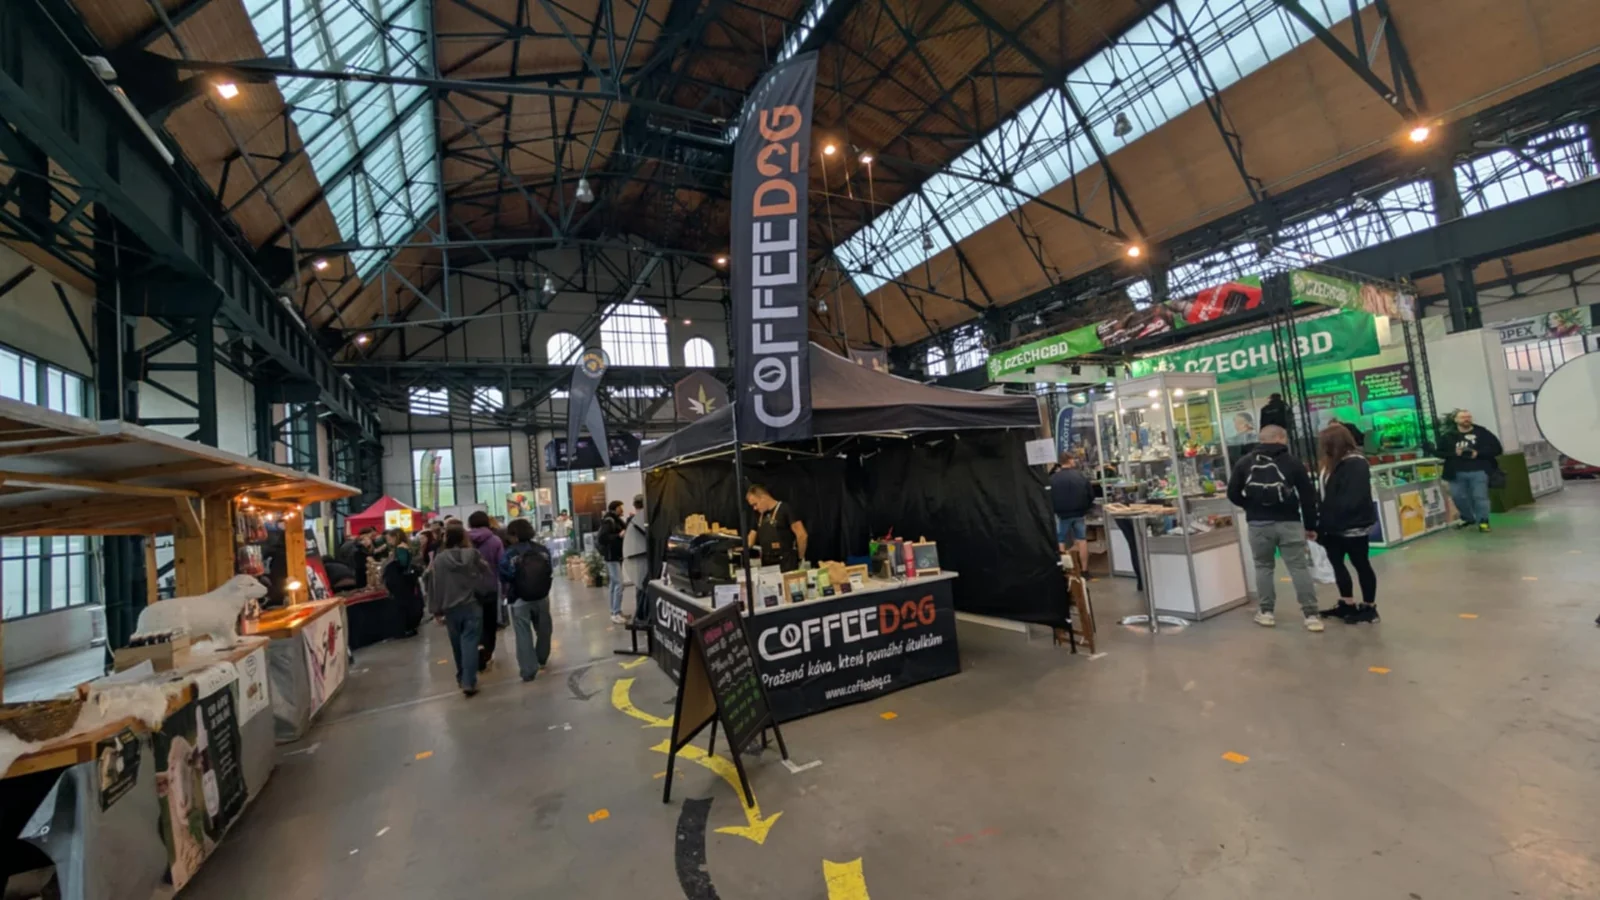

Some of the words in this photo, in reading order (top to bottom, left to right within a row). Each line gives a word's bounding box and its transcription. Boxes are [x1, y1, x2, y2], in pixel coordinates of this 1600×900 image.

[751, 104, 802, 428] COFFEEDOG
[1003, 341, 1068, 370] CZECHCBD
[1184, 331, 1333, 372] CZECHCBD
[757, 595, 936, 662] COFFEEDOG
[808, 660, 836, 678] káva,
[838, 650, 864, 669] která
[866, 639, 903, 664] pomáhá
[905, 633, 943, 652] útulkům
[825, 674, 892, 699] www.coffeedog.cz
